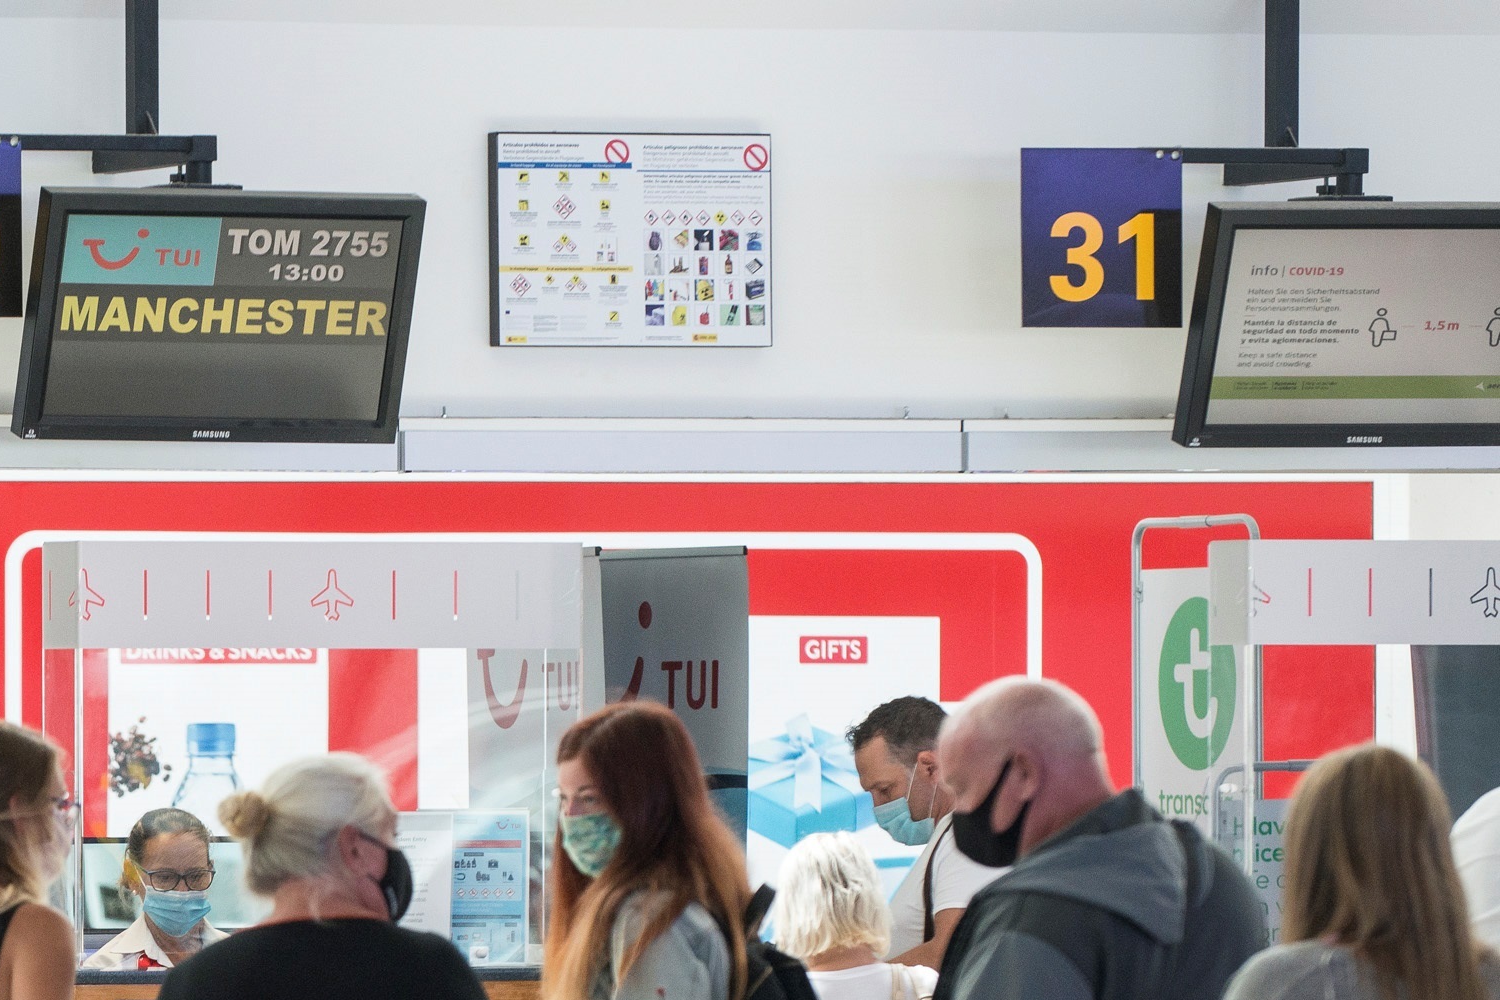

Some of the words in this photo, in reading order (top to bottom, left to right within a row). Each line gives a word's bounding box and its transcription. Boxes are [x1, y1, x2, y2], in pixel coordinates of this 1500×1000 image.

[228, 228, 301, 257] TOM
[309, 230, 390, 258] 2755
[155, 248, 201, 267] TUI
[1049, 211, 1155, 302] 31
[267, 264, 344, 282] 13:00
[1251, 265, 1278, 276] info
[1289, 267, 1344, 276] COVID-19
[60, 295, 387, 336] MANCHESTER
[1425, 320, 1445, 331] 1,5
[1447, 322, 1460, 331] m
[192, 430, 231, 439] SAMSUNG
[804, 639, 862, 660] GIFTS
[661, 660, 719, 710] TUI
